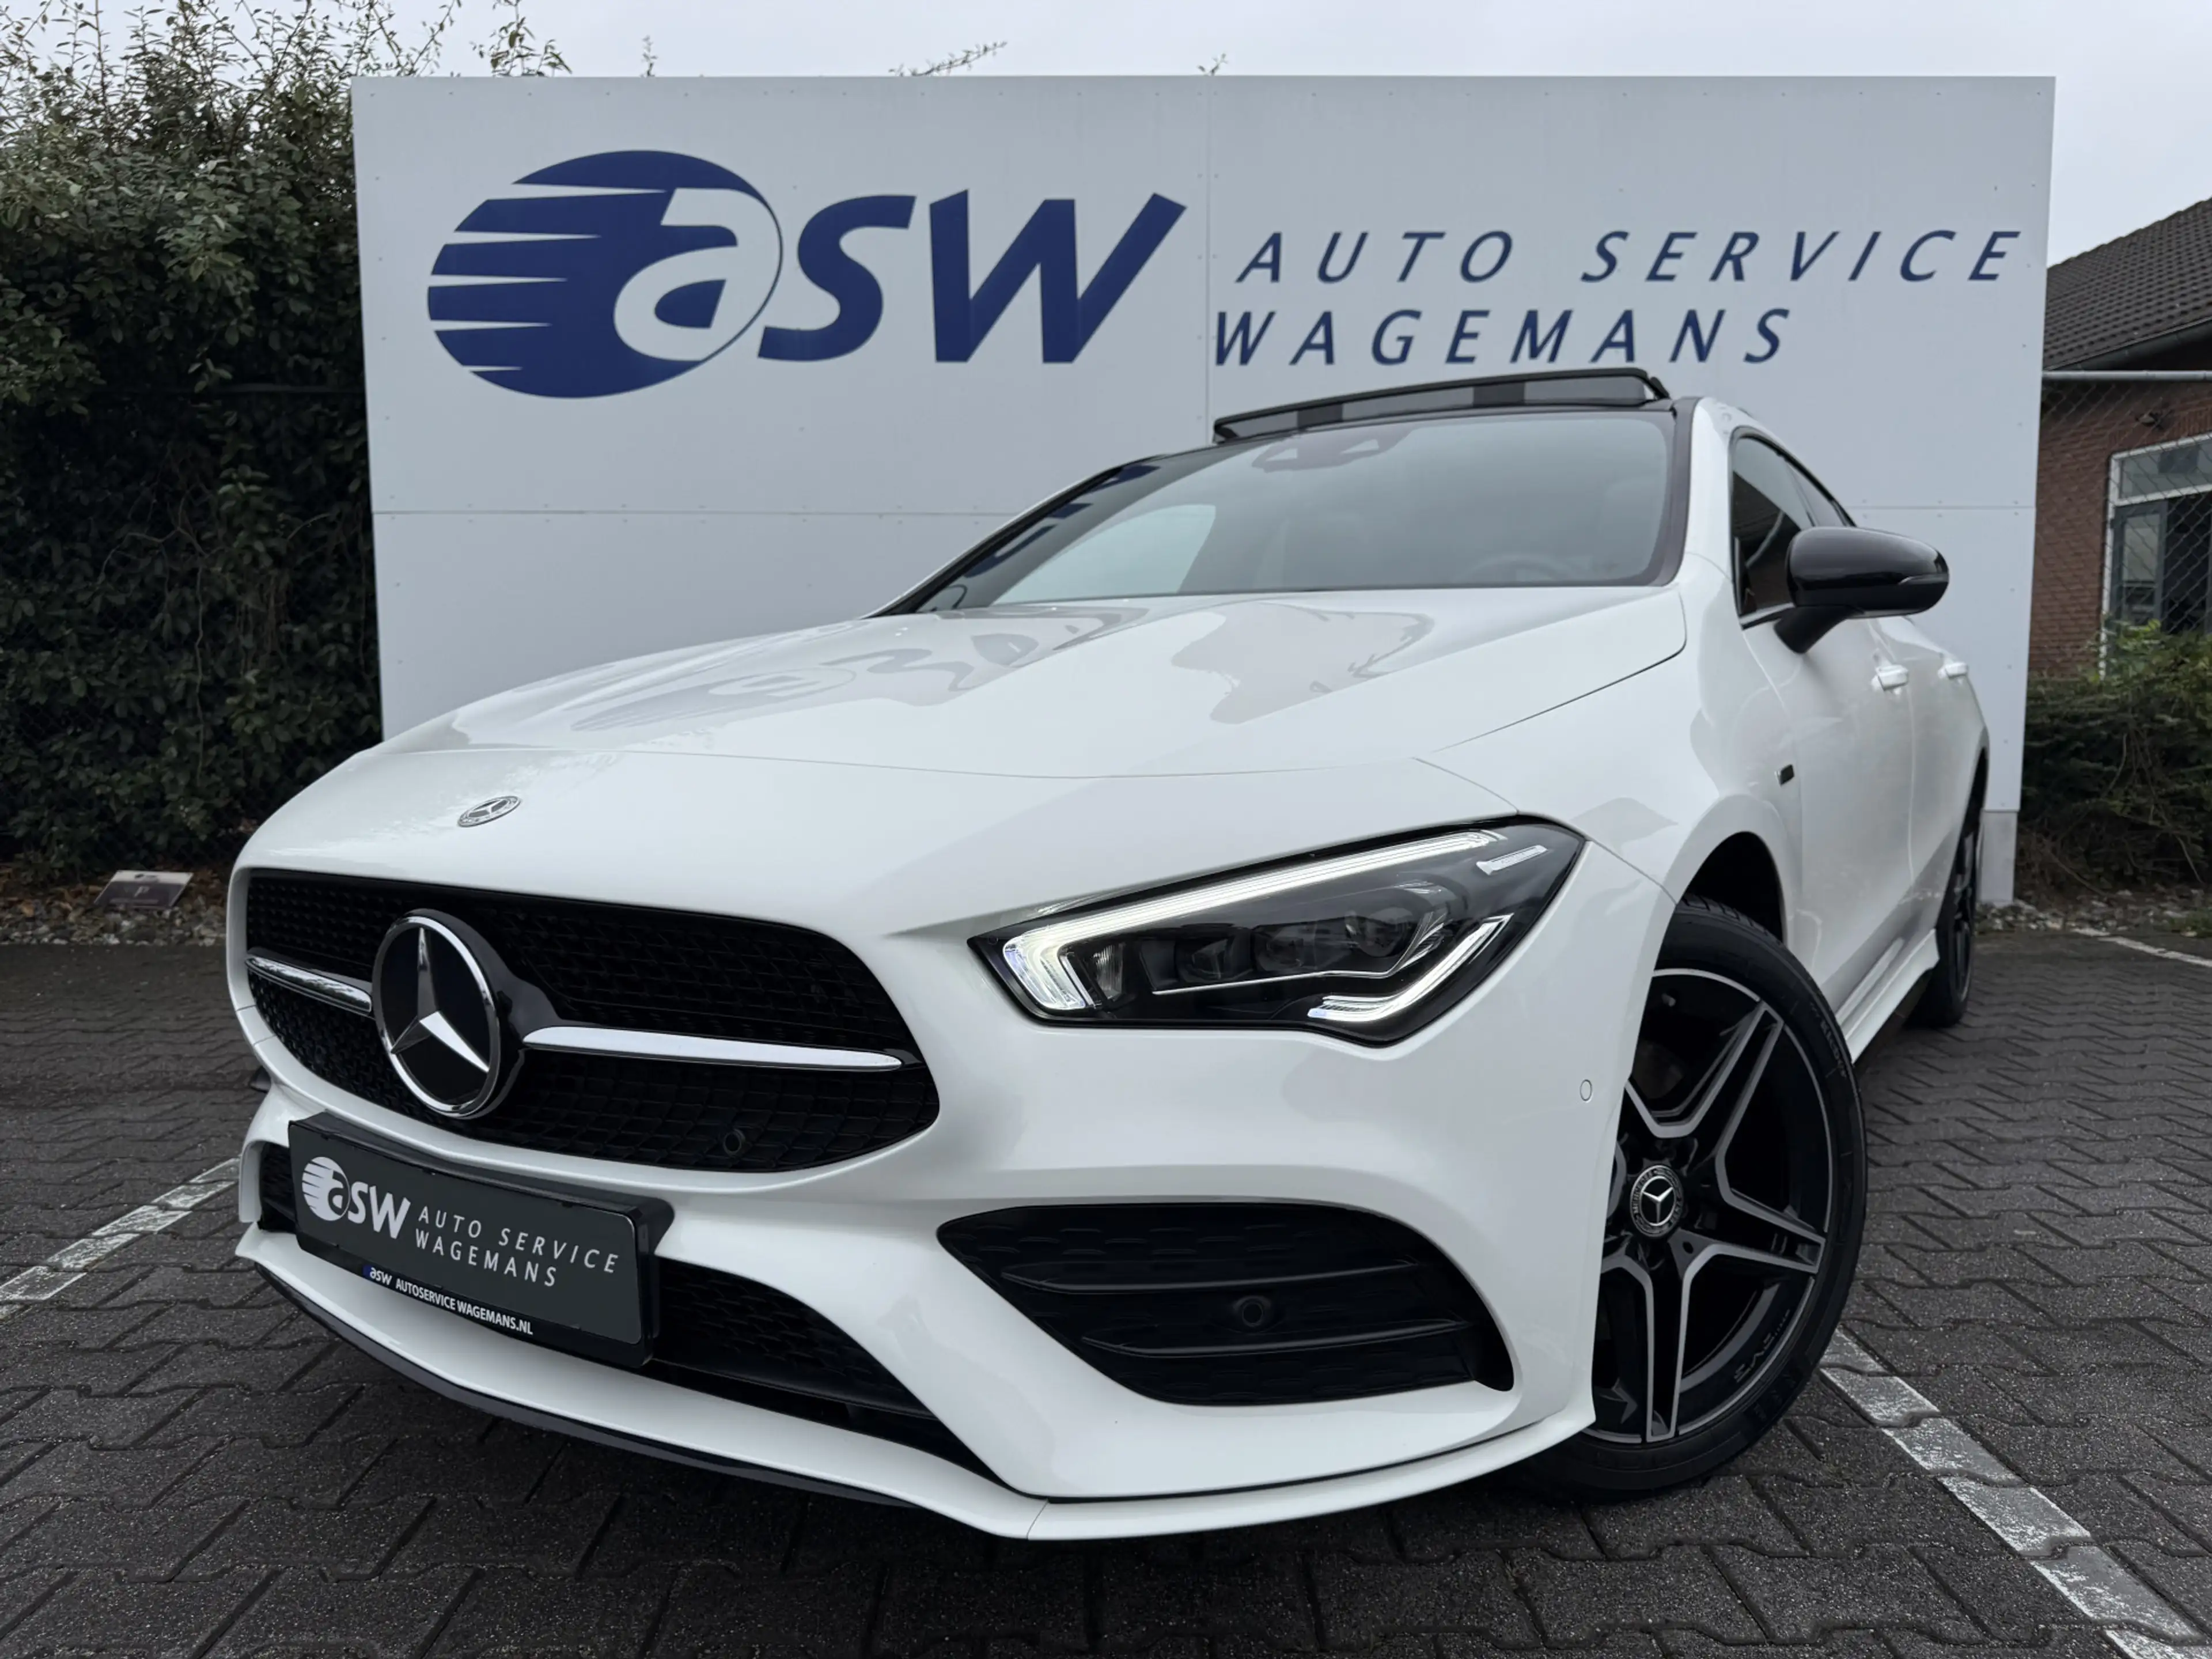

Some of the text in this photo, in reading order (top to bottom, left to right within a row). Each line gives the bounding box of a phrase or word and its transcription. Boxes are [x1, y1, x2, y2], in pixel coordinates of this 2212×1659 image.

[1236, 230, 2021, 283] AUTO SERVICE
[1215, 308, 1790, 366] WAGEMANS
[415, 1228, 556, 1287] WAGEMANS
[418, 1206, 619, 1273] AUTO SERVICE
[396, 1278, 456, 1310] AUTOSERVICE
[457, 1300, 533, 1335] WAGEMANS.NL
